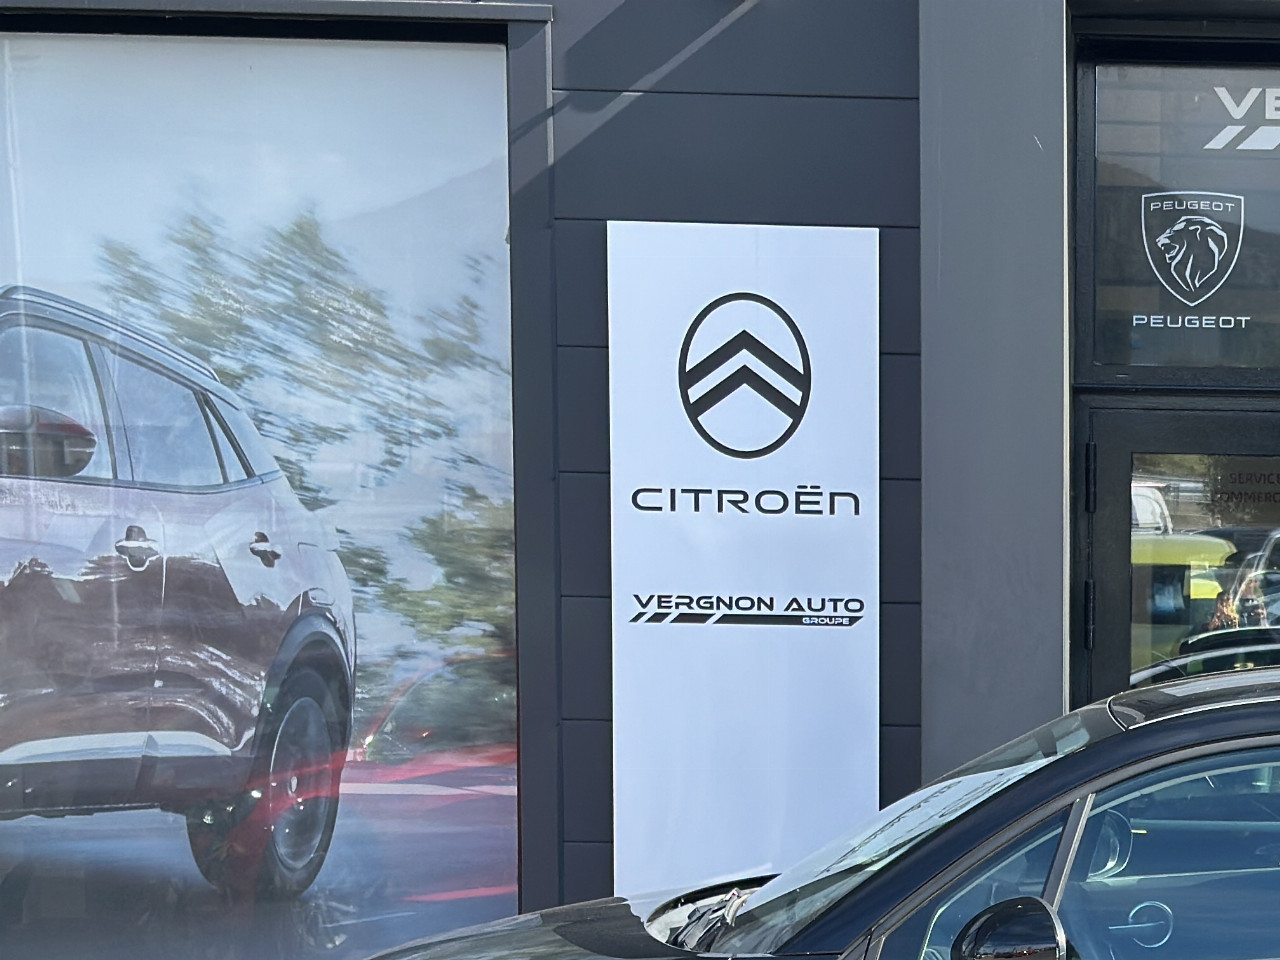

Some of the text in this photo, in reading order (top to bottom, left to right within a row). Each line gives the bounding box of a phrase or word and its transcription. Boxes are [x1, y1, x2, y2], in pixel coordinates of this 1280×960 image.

[1150, 200, 1235, 212] PEUGEOT
[1132, 315, 1251, 329] PEUGEOT
[633, 594, 865, 614] VERGNON AUTO
[802, 617, 850, 626] GROUPE
